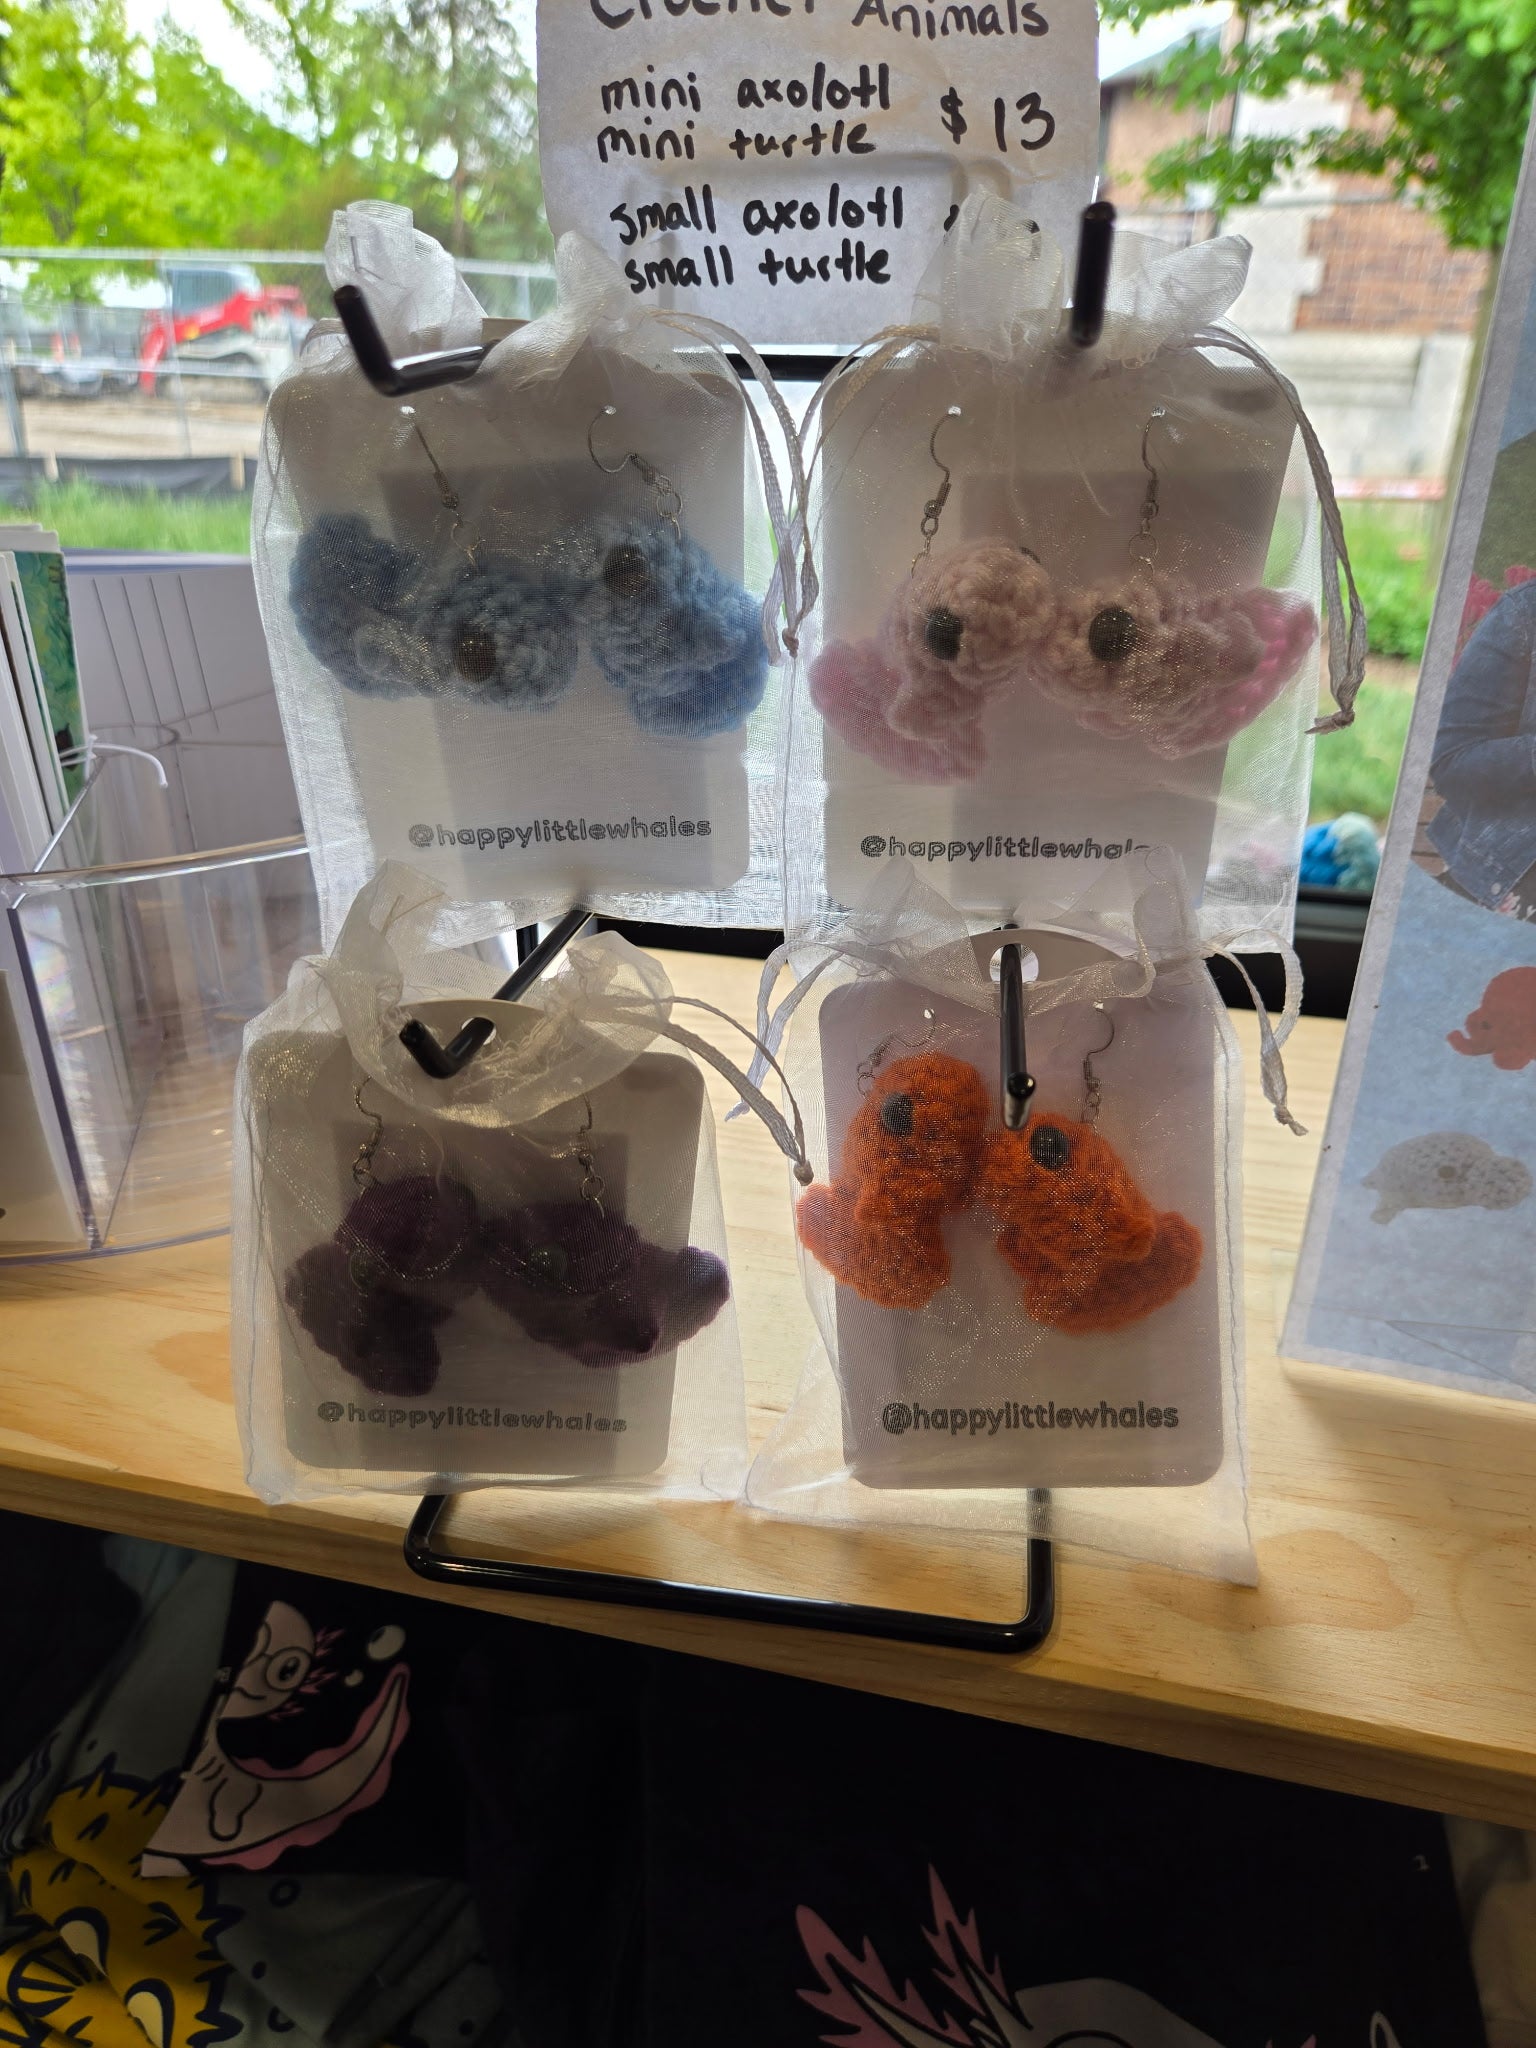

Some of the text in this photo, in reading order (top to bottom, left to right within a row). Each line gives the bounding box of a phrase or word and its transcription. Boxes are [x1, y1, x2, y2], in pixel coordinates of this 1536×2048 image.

[851, 0, 1050, 41] Animals
[601, 61, 891, 114] mini axolotl
[596, 116, 877, 164] mini turtle
[609, 183, 717, 246] small
[742, 182, 903, 236] axolotl
[621, 237, 891, 294] small turtle
[408, 815, 712, 850] @happylittlewhales
[860, 835, 1151, 862] @happylittlewhal
[317, 1402, 628, 1433] @happylittlewhales
[882, 1401, 1180, 1436] @happylittlewhales
